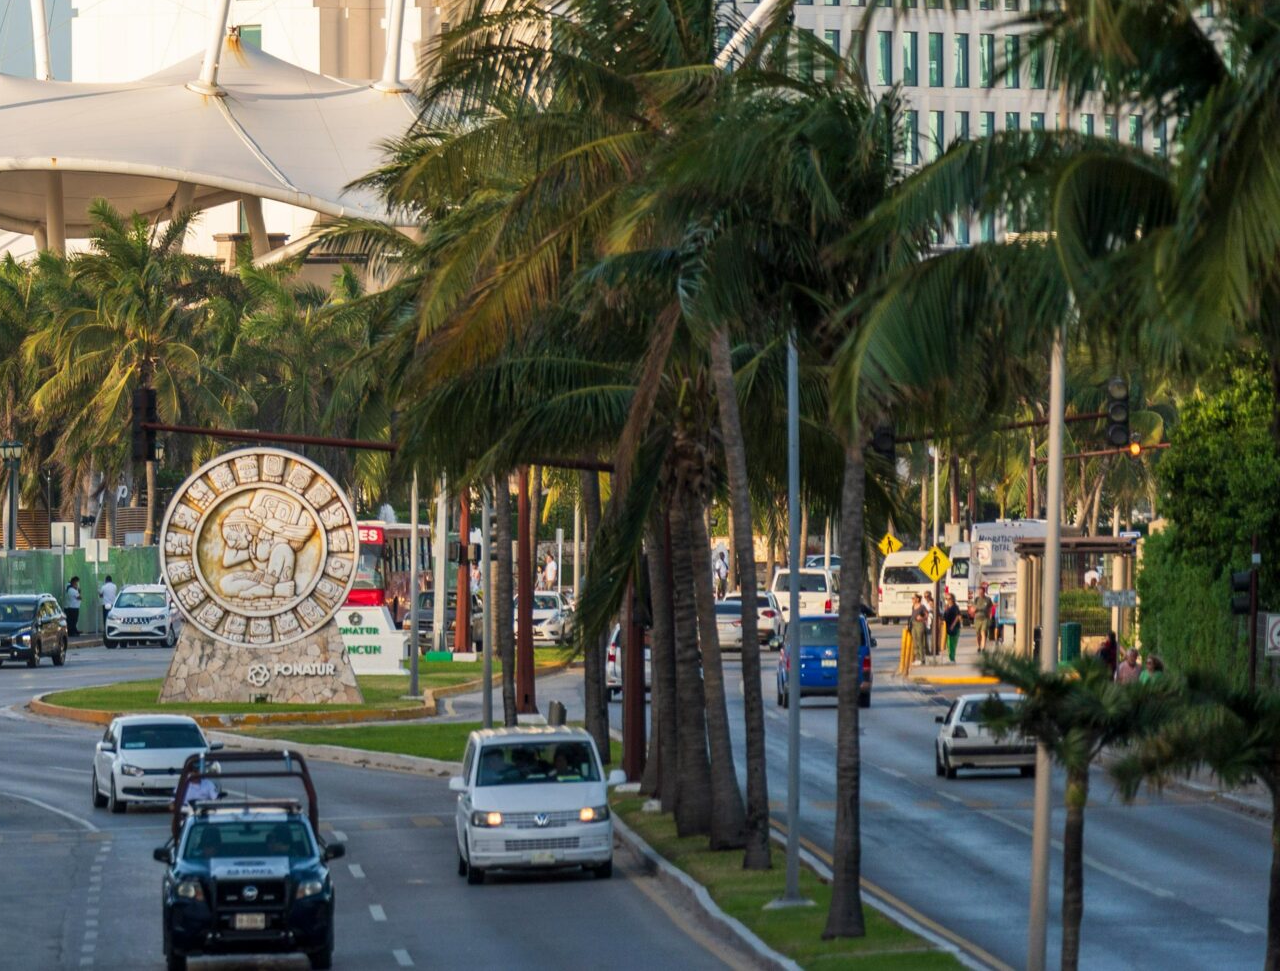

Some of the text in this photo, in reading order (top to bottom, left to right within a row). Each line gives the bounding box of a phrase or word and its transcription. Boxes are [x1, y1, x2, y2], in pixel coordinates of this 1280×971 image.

[359, 530, 378, 541] ES
[338, 627, 380, 636] ONATUR
[347, 645, 382, 655] NCUN
[274, 662, 335, 676] FONATUR
